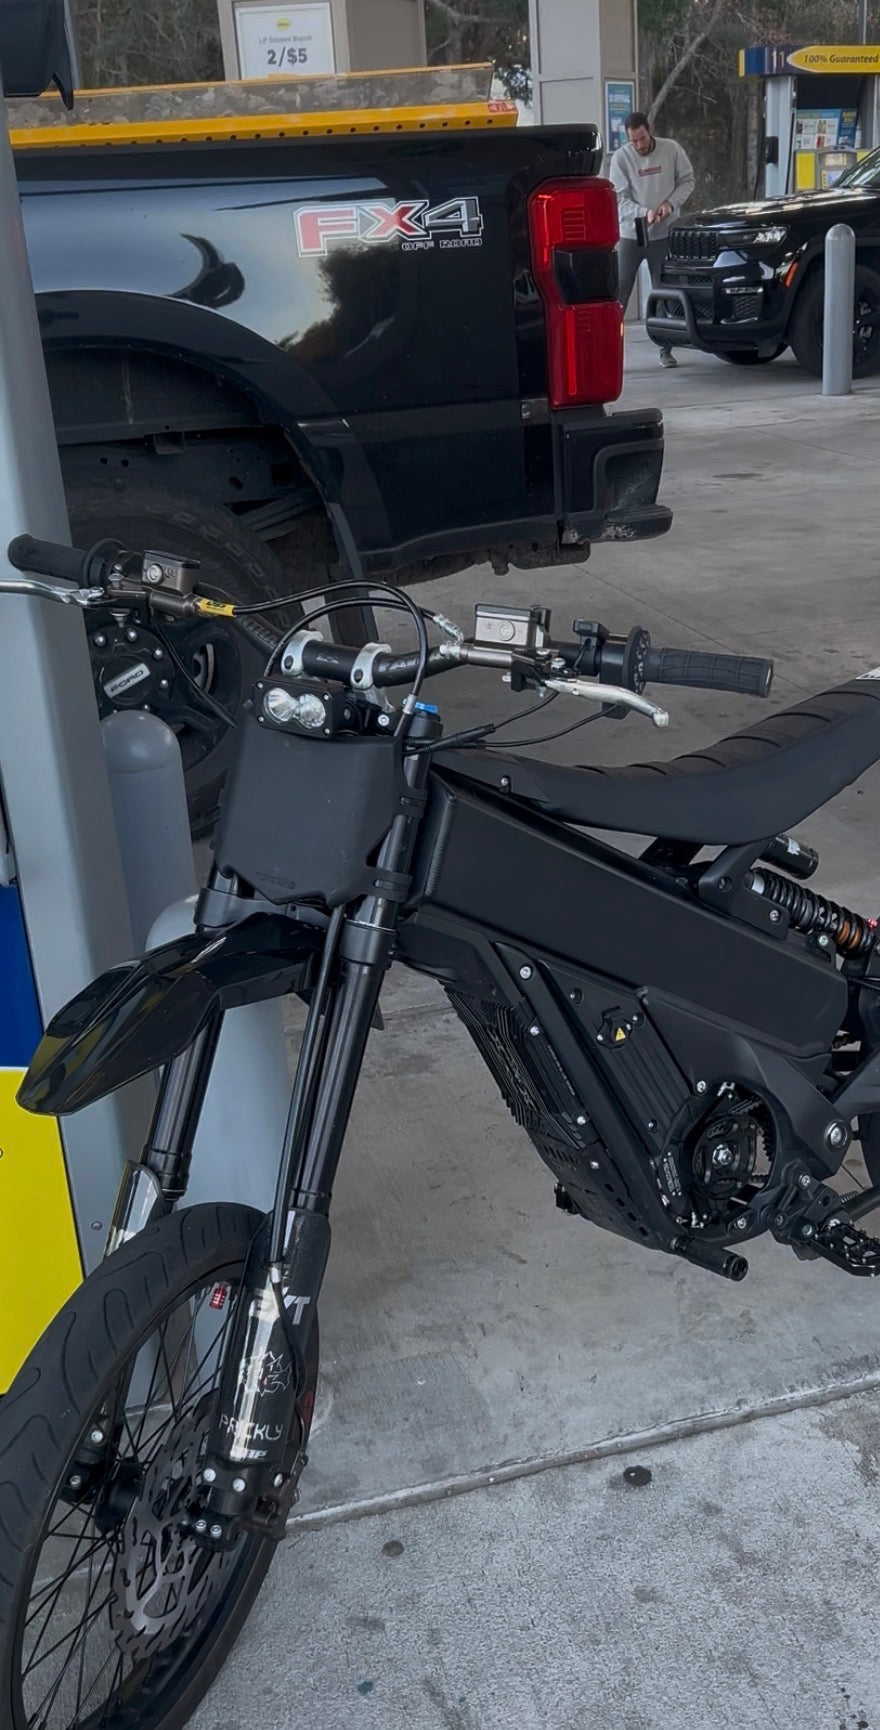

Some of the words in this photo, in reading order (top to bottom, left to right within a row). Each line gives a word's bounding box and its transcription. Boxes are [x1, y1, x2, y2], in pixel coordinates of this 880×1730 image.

[267, 46, 308, 67] 2/$5
[804, 54, 827, 63] 100%
[829, 54, 880, 63] Guaranteed
[294, 197, 483, 257] FX4
[402, 241, 434, 251] OFF
[440, 238, 483, 249] ROAD
[110, 670, 144, 692] FORD
[218, 1413, 284, 1440] PRKLY
